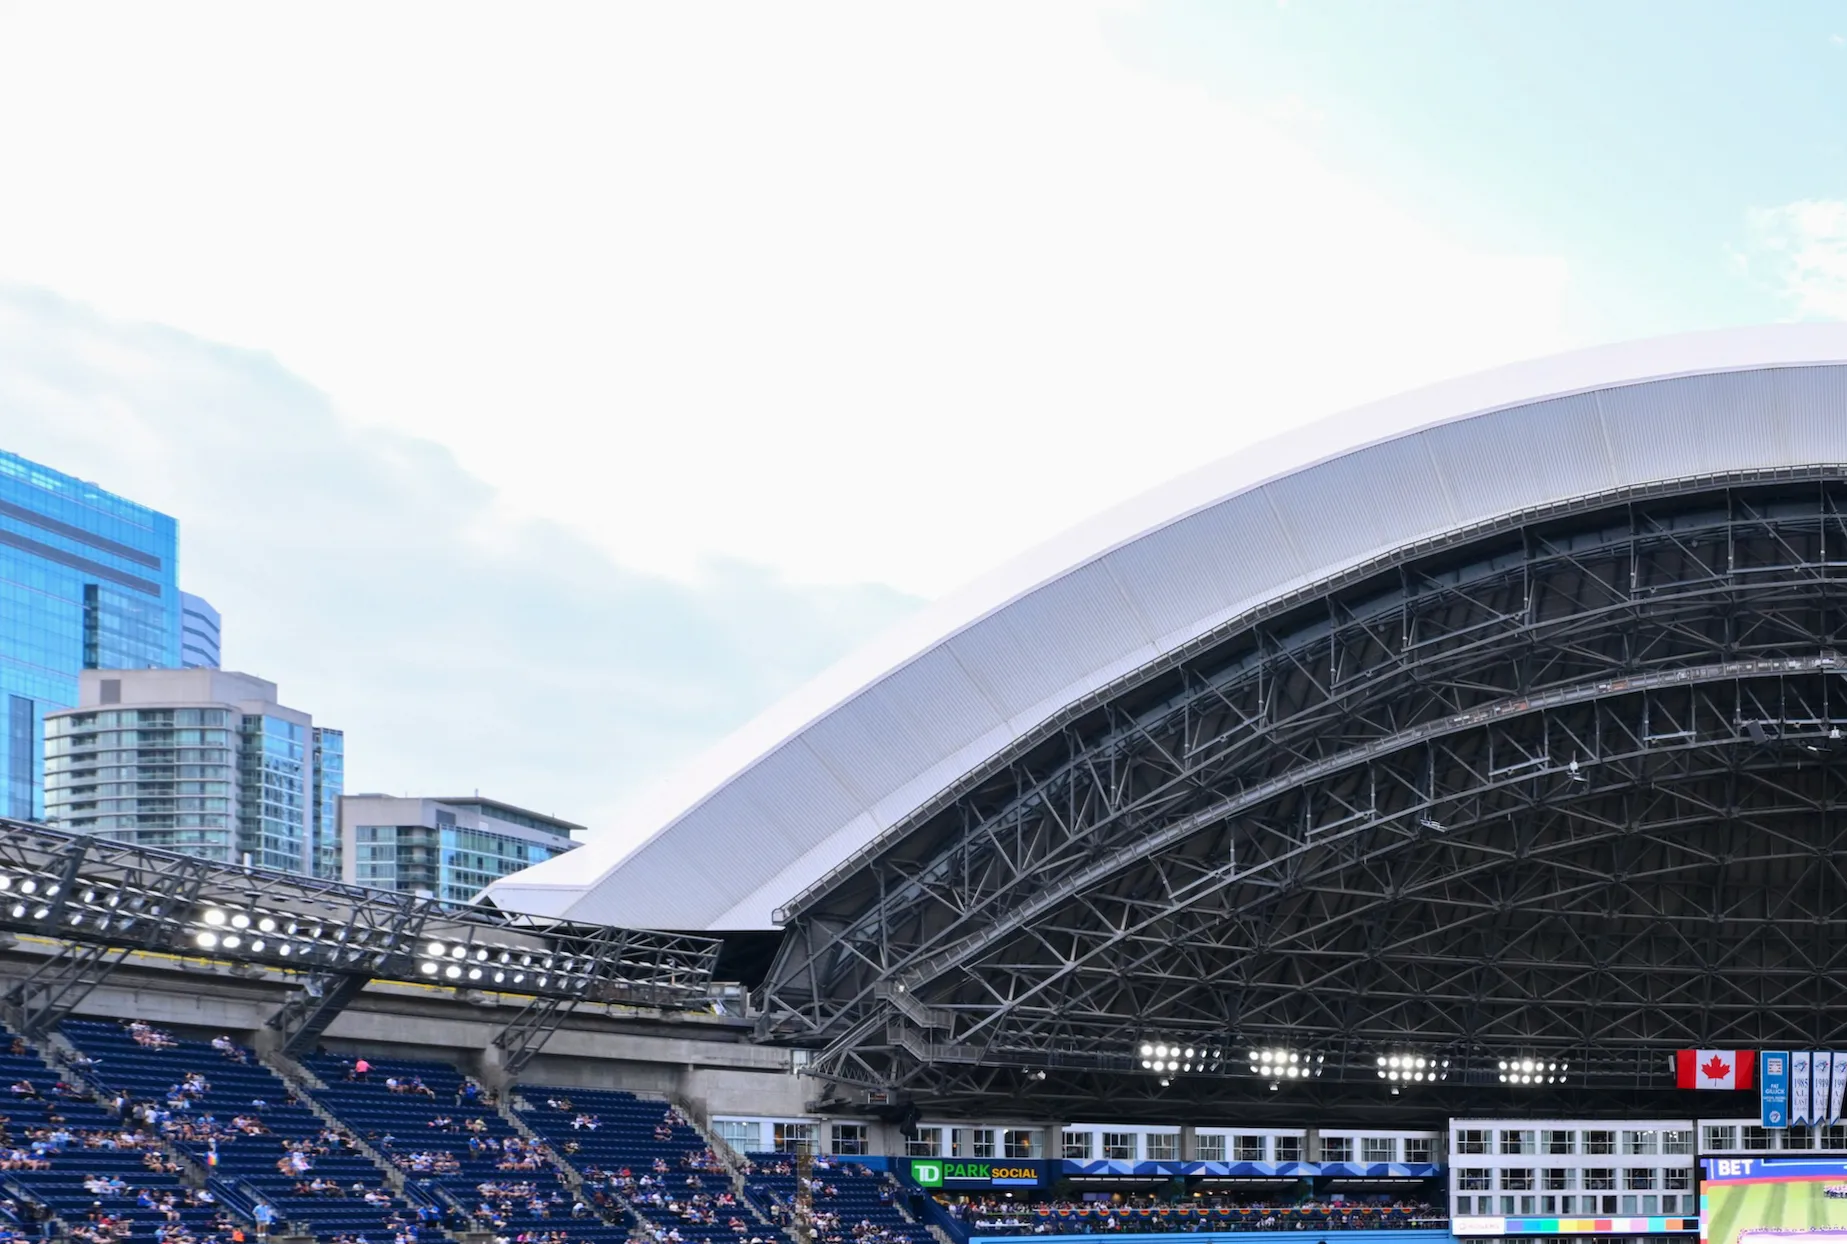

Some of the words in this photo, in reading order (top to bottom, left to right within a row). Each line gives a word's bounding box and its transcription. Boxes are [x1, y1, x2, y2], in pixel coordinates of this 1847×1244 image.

[914, 1164, 940, 1182] TD
[944, 1164, 991, 1178] PARK
[991, 1168, 1038, 1179] SOCIAL
[1718, 1158, 1754, 1176] BET
